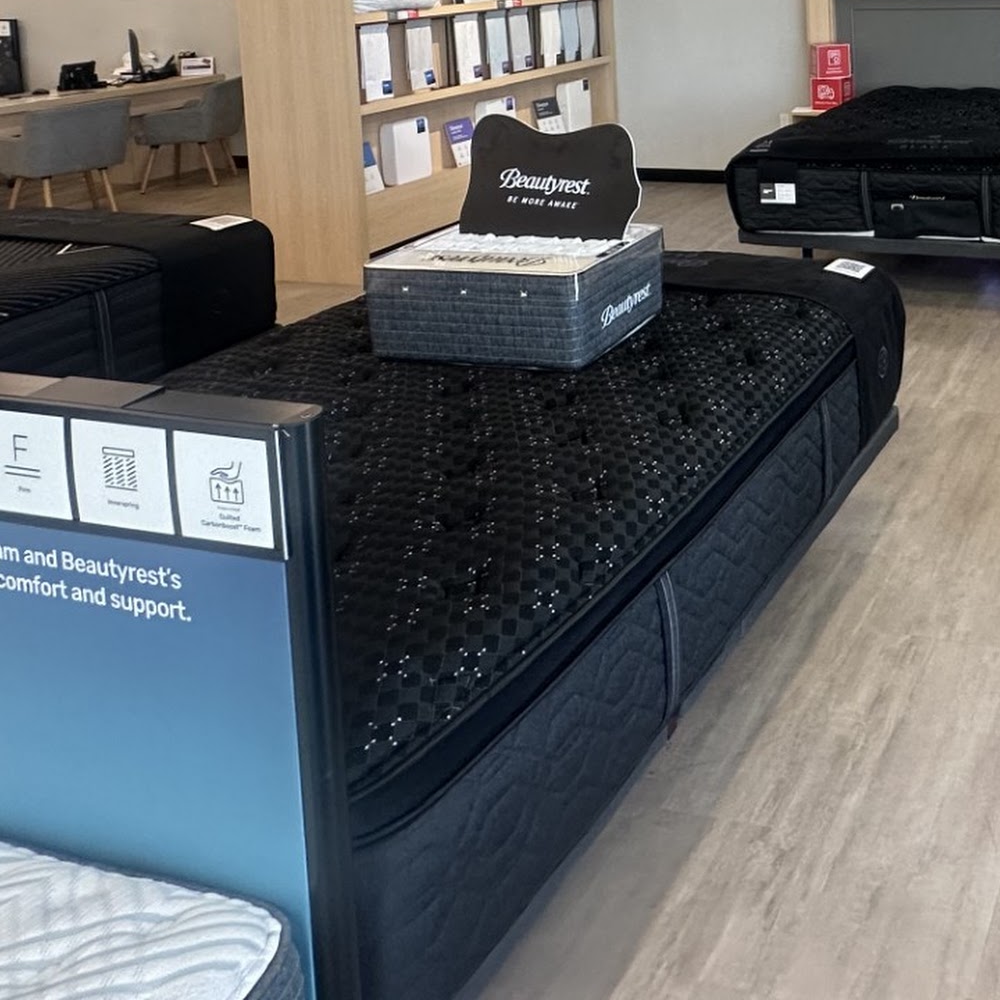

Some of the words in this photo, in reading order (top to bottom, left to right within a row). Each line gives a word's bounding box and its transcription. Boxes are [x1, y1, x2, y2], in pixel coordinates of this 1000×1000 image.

[499, 167, 590, 195] Beautyrest
[507, 195, 518, 203] BE
[521, 196, 545, 206] MORE
[547, 199, 579, 209] AWAKE
[601, 282, 651, 329] Beautyrest
[13, 434, 28, 461] F
[23, 549, 57, 569] and
[61, 551, 182, 590] Beautyrest's
[71, 587, 106, 607] and
[110, 592, 192, 622] support.
